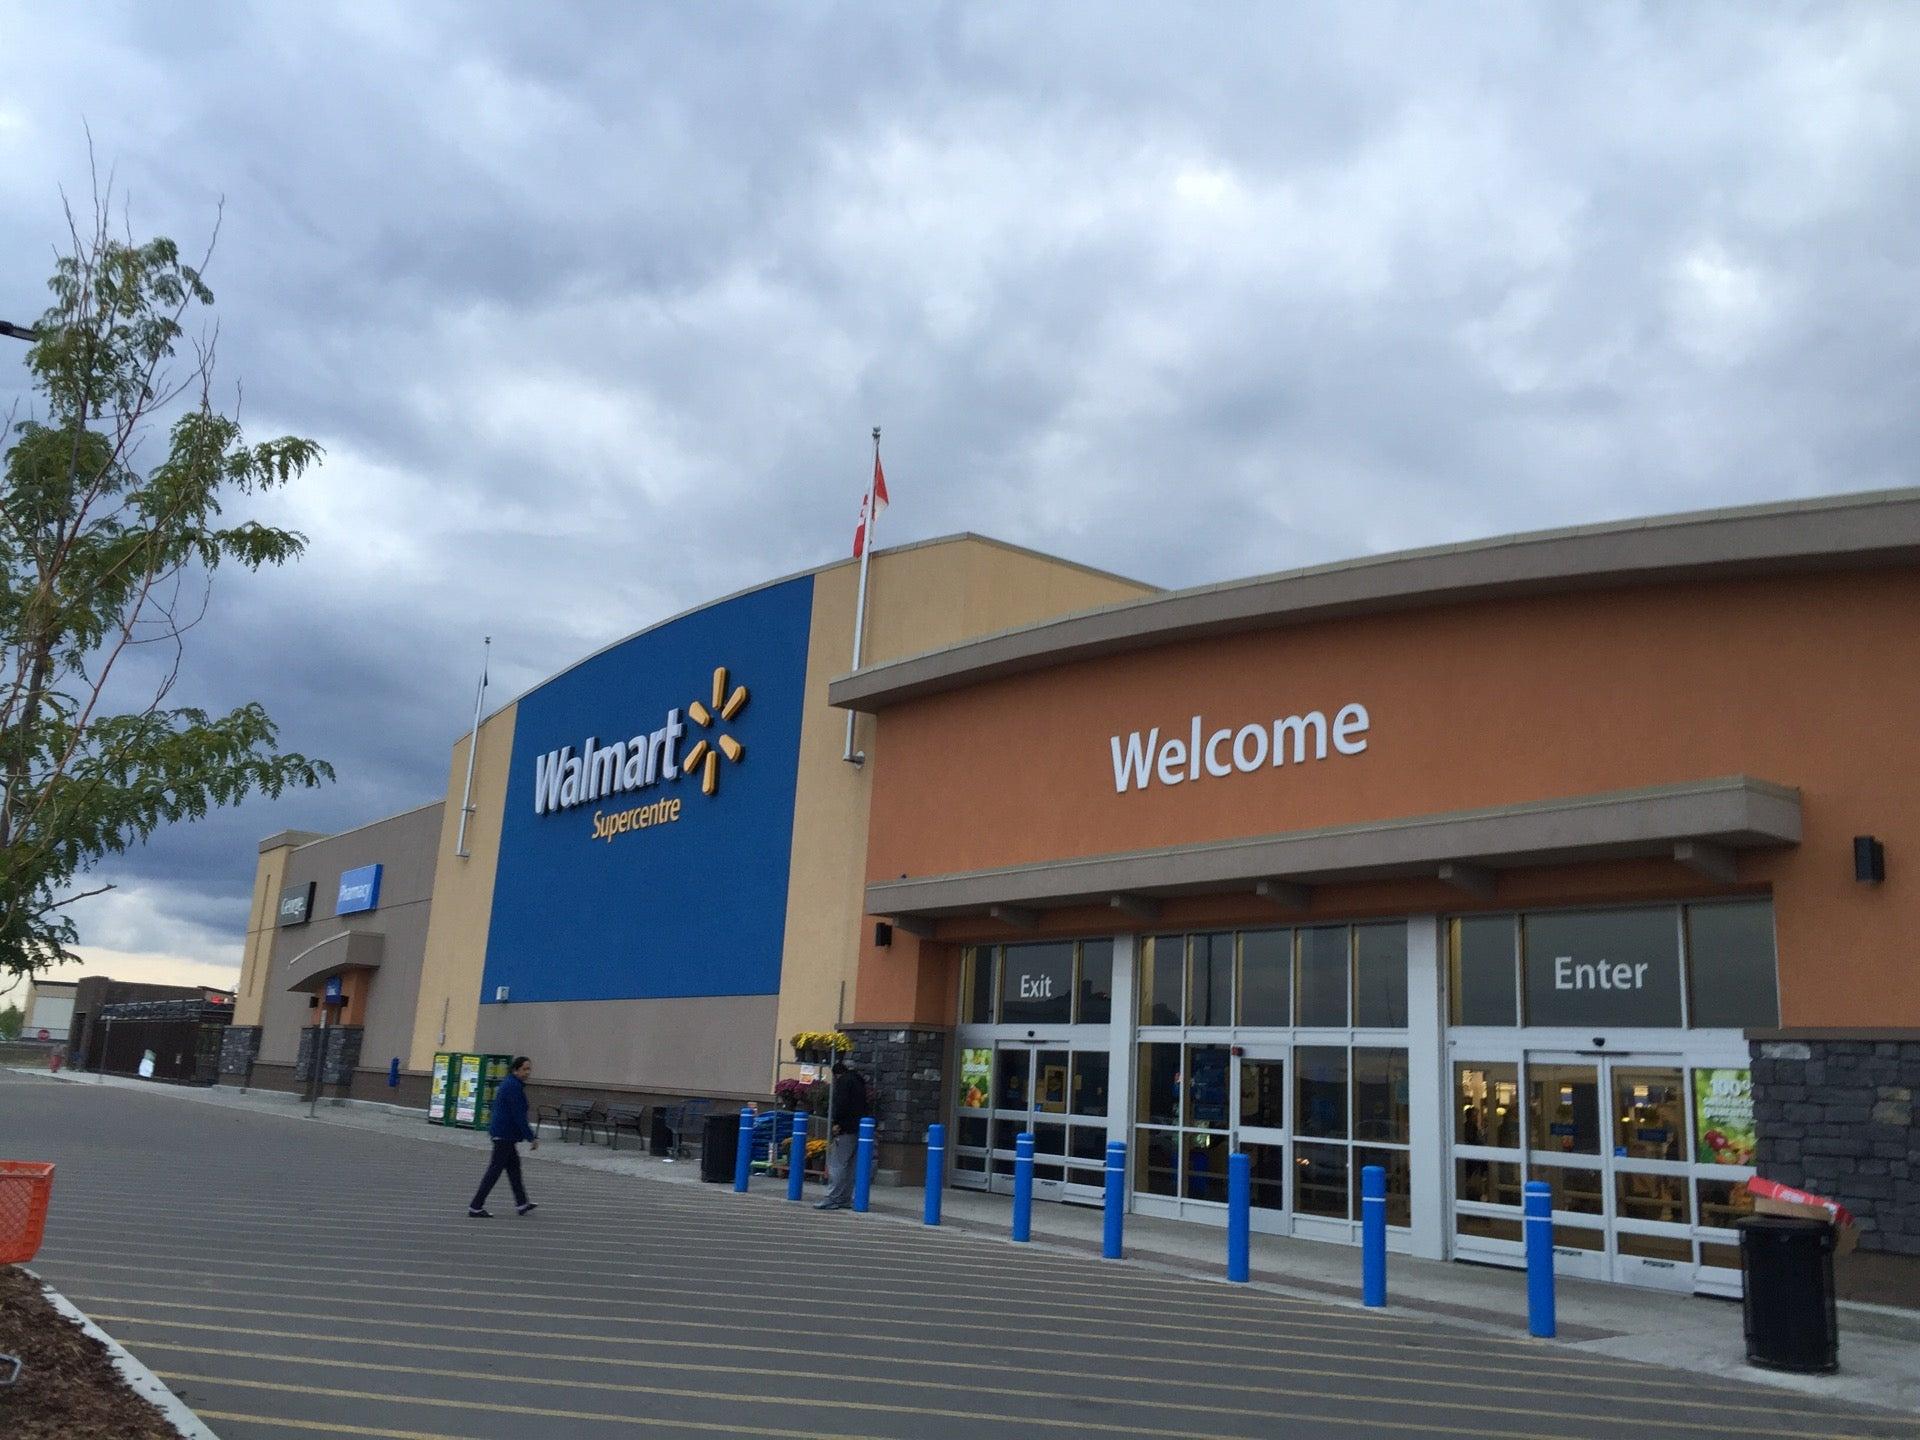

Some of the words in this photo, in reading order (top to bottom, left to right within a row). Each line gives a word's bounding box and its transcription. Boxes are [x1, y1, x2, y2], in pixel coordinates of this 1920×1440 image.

[535, 708, 684, 815] Walmart
[1110, 703, 1370, 793] Welcome
[592, 797, 681, 842] Supercentre
[1020, 974, 1052, 998] Exit
[1555, 956, 1648, 990] Enter
